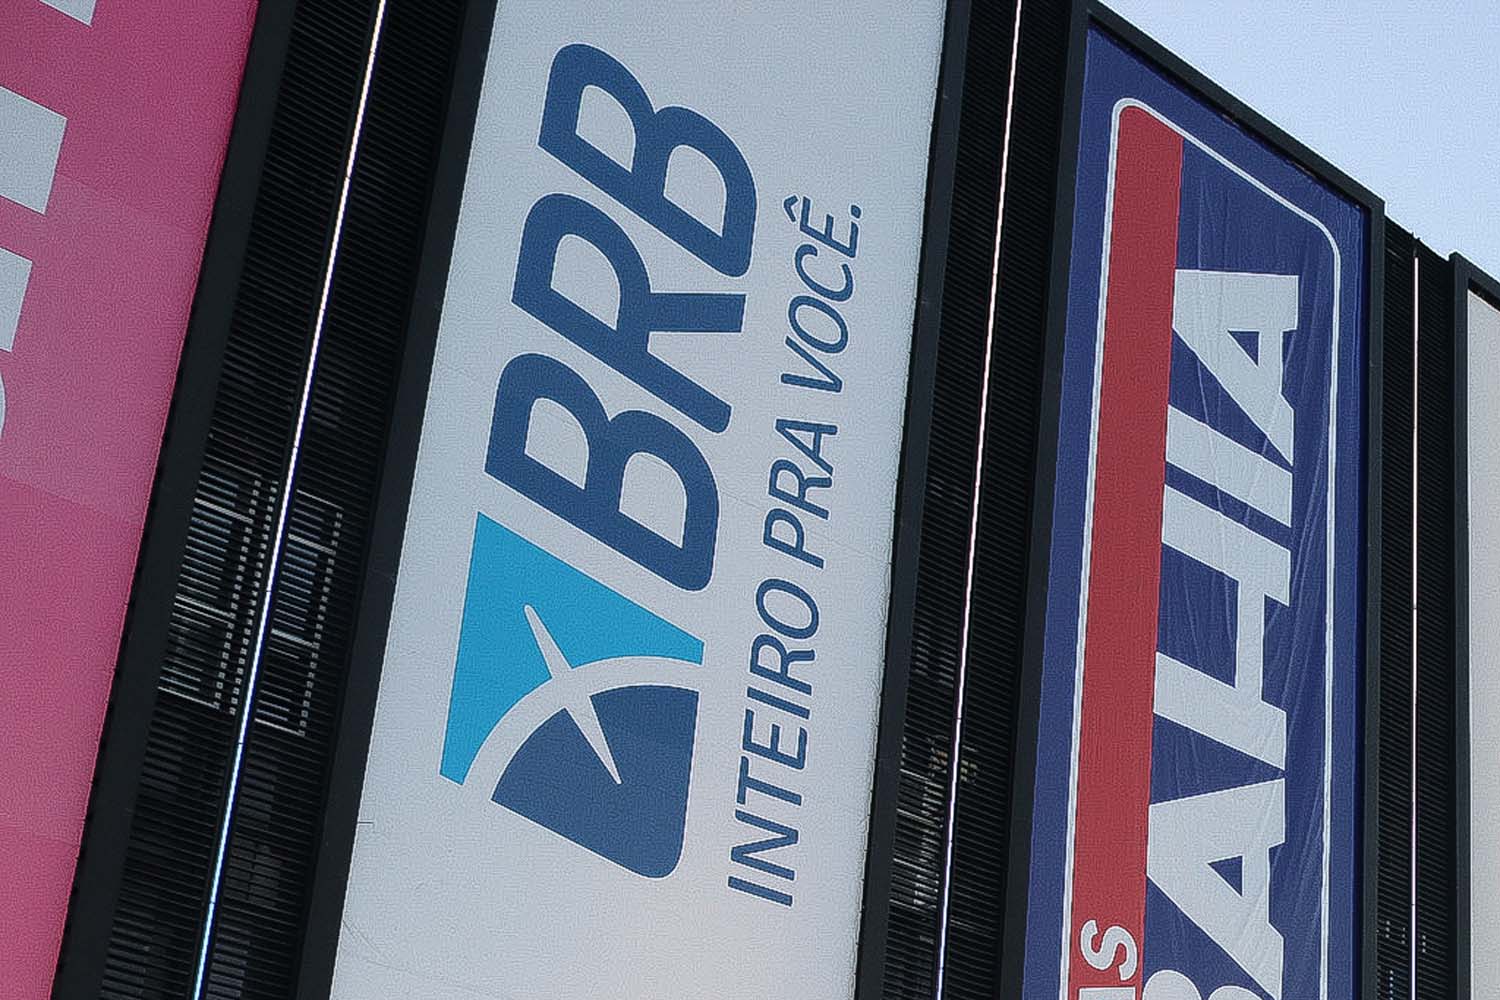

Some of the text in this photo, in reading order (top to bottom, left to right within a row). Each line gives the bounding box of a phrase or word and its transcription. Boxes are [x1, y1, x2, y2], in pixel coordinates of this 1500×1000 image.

[485, 43, 757, 591] BRB
[727, 195, 863, 907] INTEIRO PRA VOCÊ.
